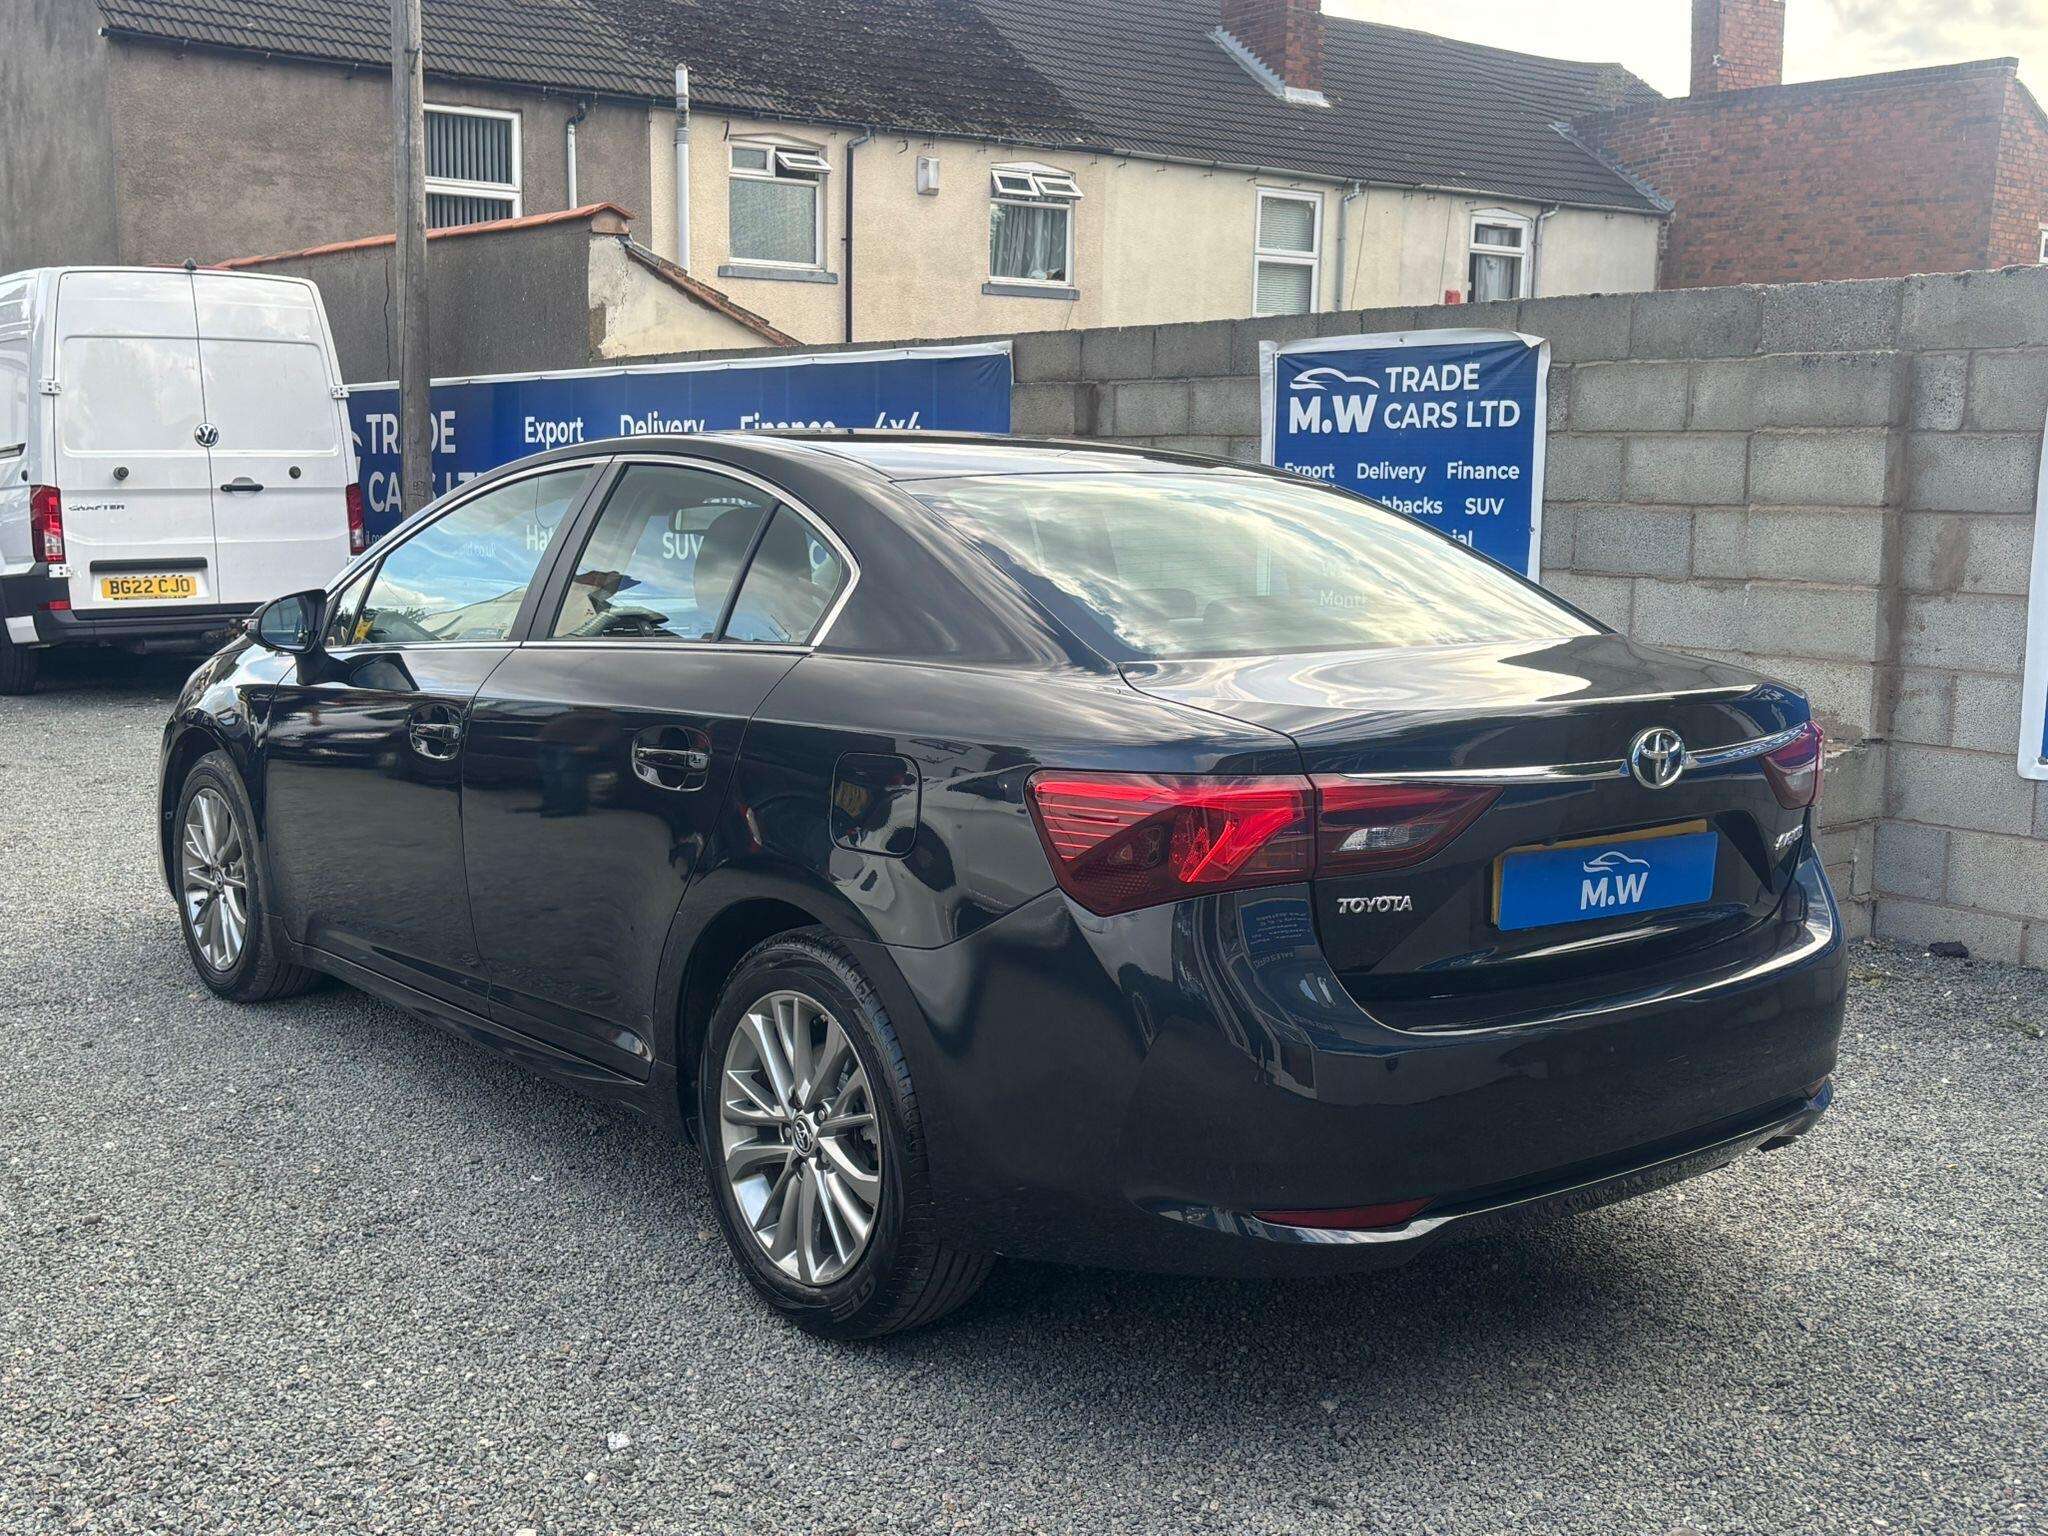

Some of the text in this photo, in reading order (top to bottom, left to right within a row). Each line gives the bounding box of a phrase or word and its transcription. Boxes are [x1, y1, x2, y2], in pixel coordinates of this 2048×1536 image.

[1386, 363, 1480, 393] TRADE
[1289, 394, 1378, 434] M.W
[1384, 400, 1521, 430] CARS LTD
[366, 411, 456, 454] TRE
[525, 416, 585, 449] Export
[1357, 462, 1426, 484] Delivery
[1446, 461, 1520, 480] Finance
[1464, 497, 1505, 515] SUV
[662, 532, 704, 560] SUV
[109, 578, 191, 595] BG22 CJO
[1337, 895, 1413, 914] TOYOTA
[1580, 872, 1649, 910] M.W
